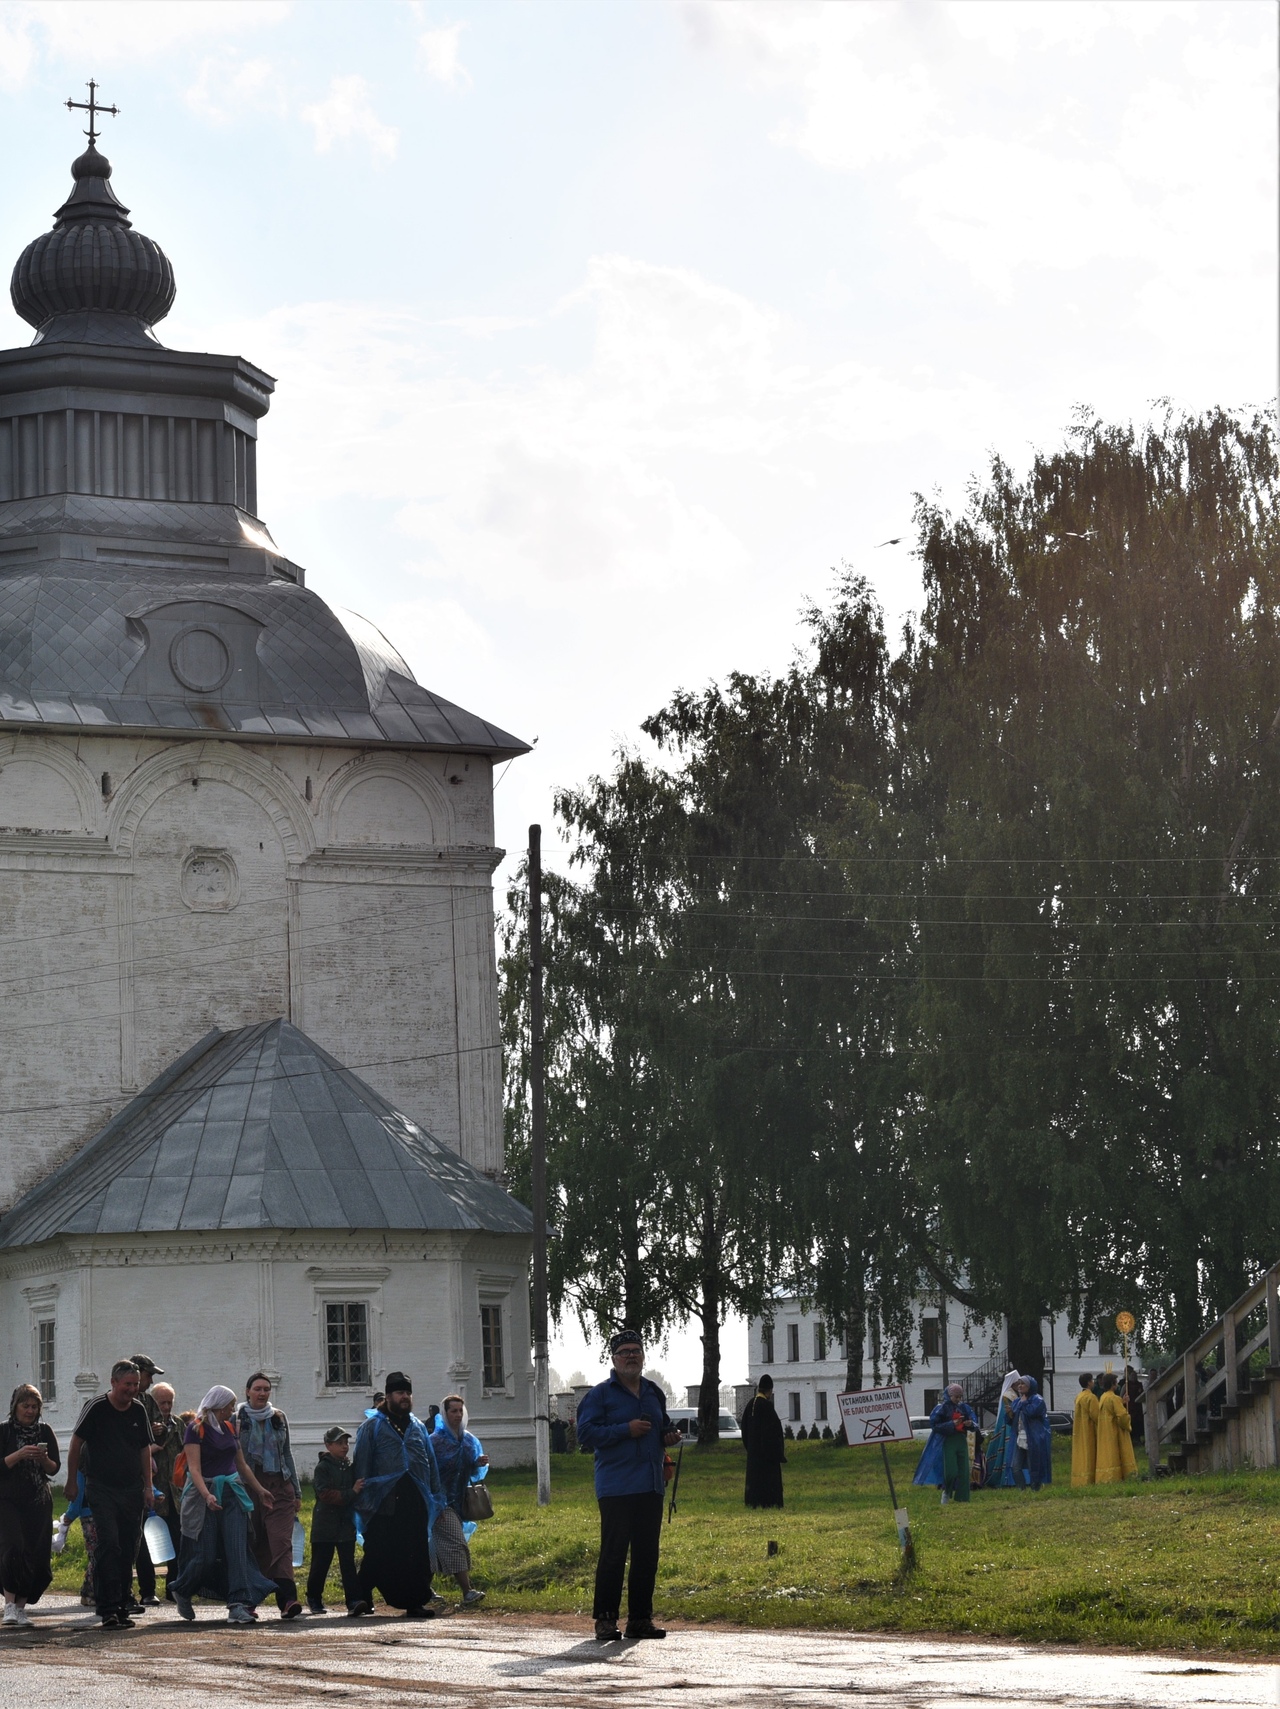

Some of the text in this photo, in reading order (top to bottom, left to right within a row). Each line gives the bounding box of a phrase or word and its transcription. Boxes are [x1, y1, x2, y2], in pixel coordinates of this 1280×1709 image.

[841, 1391, 901, 1406] УСТАНОВКА ПАЛАТОК
[843, 1401, 903, 1416] НЕ БЛАГОСЛОВЛЯЕТСЯ
